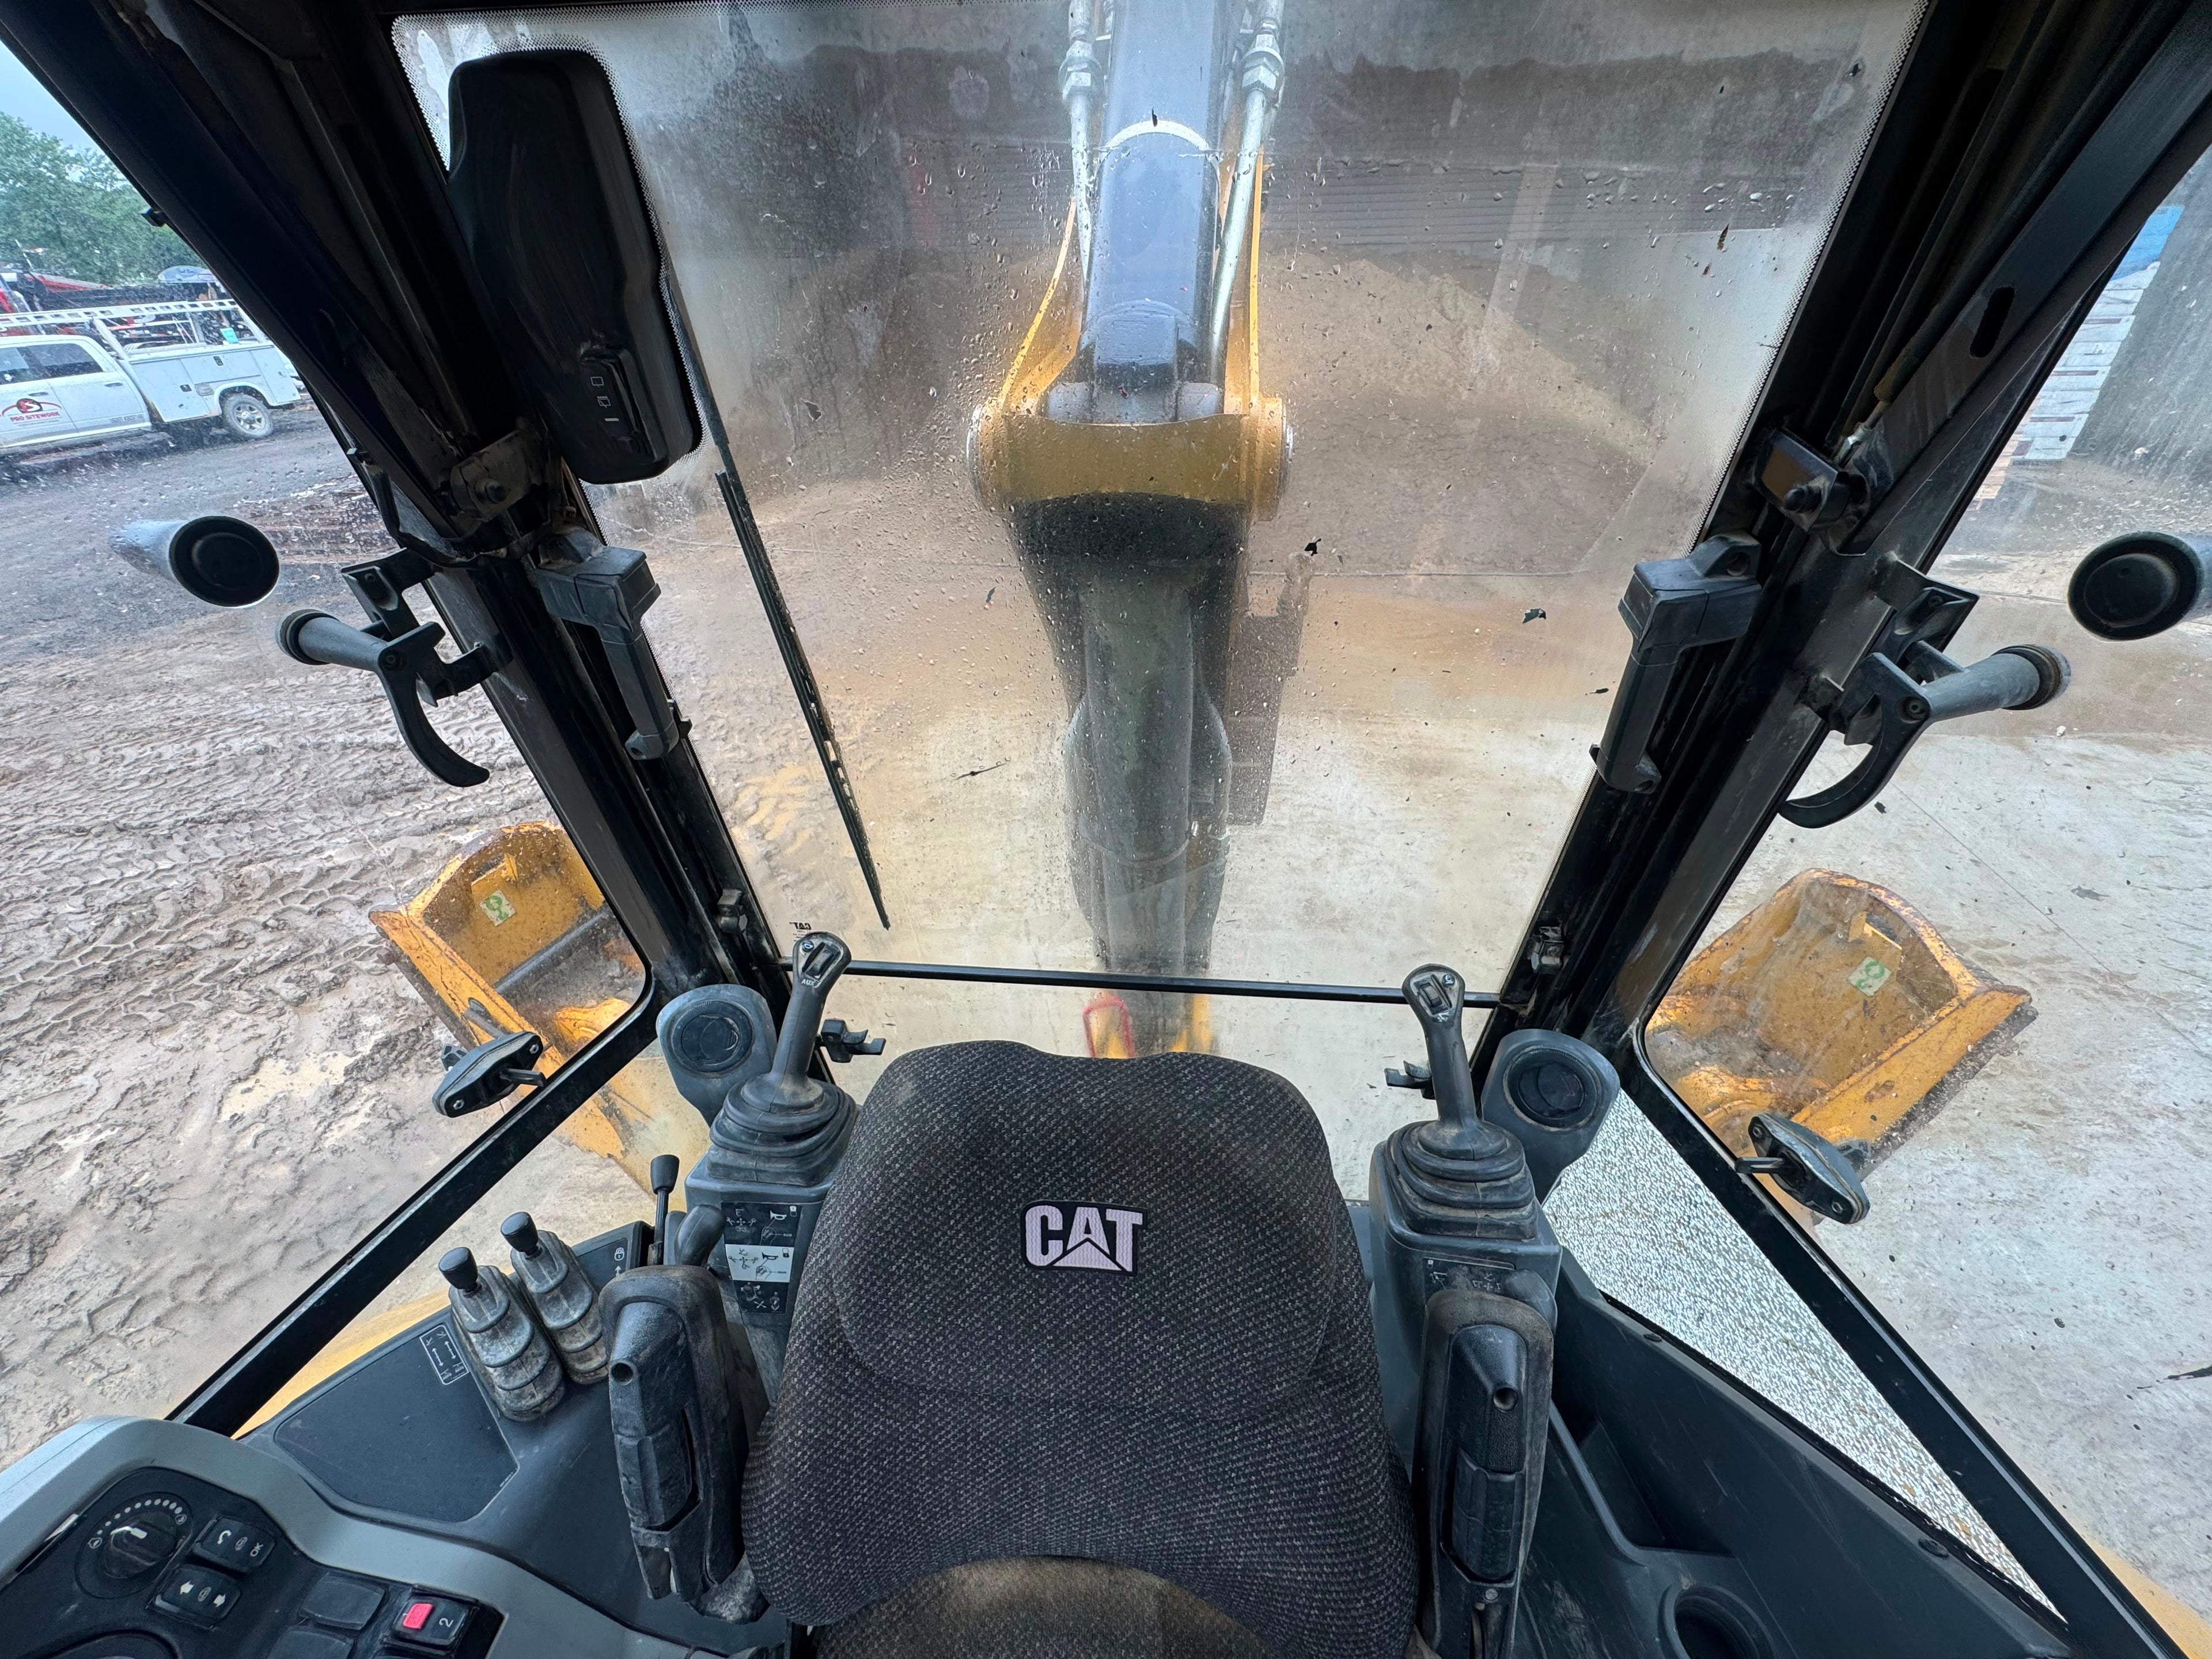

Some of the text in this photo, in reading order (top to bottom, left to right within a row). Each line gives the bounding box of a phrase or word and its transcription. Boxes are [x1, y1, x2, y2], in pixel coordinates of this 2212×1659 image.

[25, 411, 60, 420] SITEWORK
[1025, 1205, 1143, 1272] CAT
[249, 1542, 264, 1557] OK
[438, 1618, 454, 1628] 2
